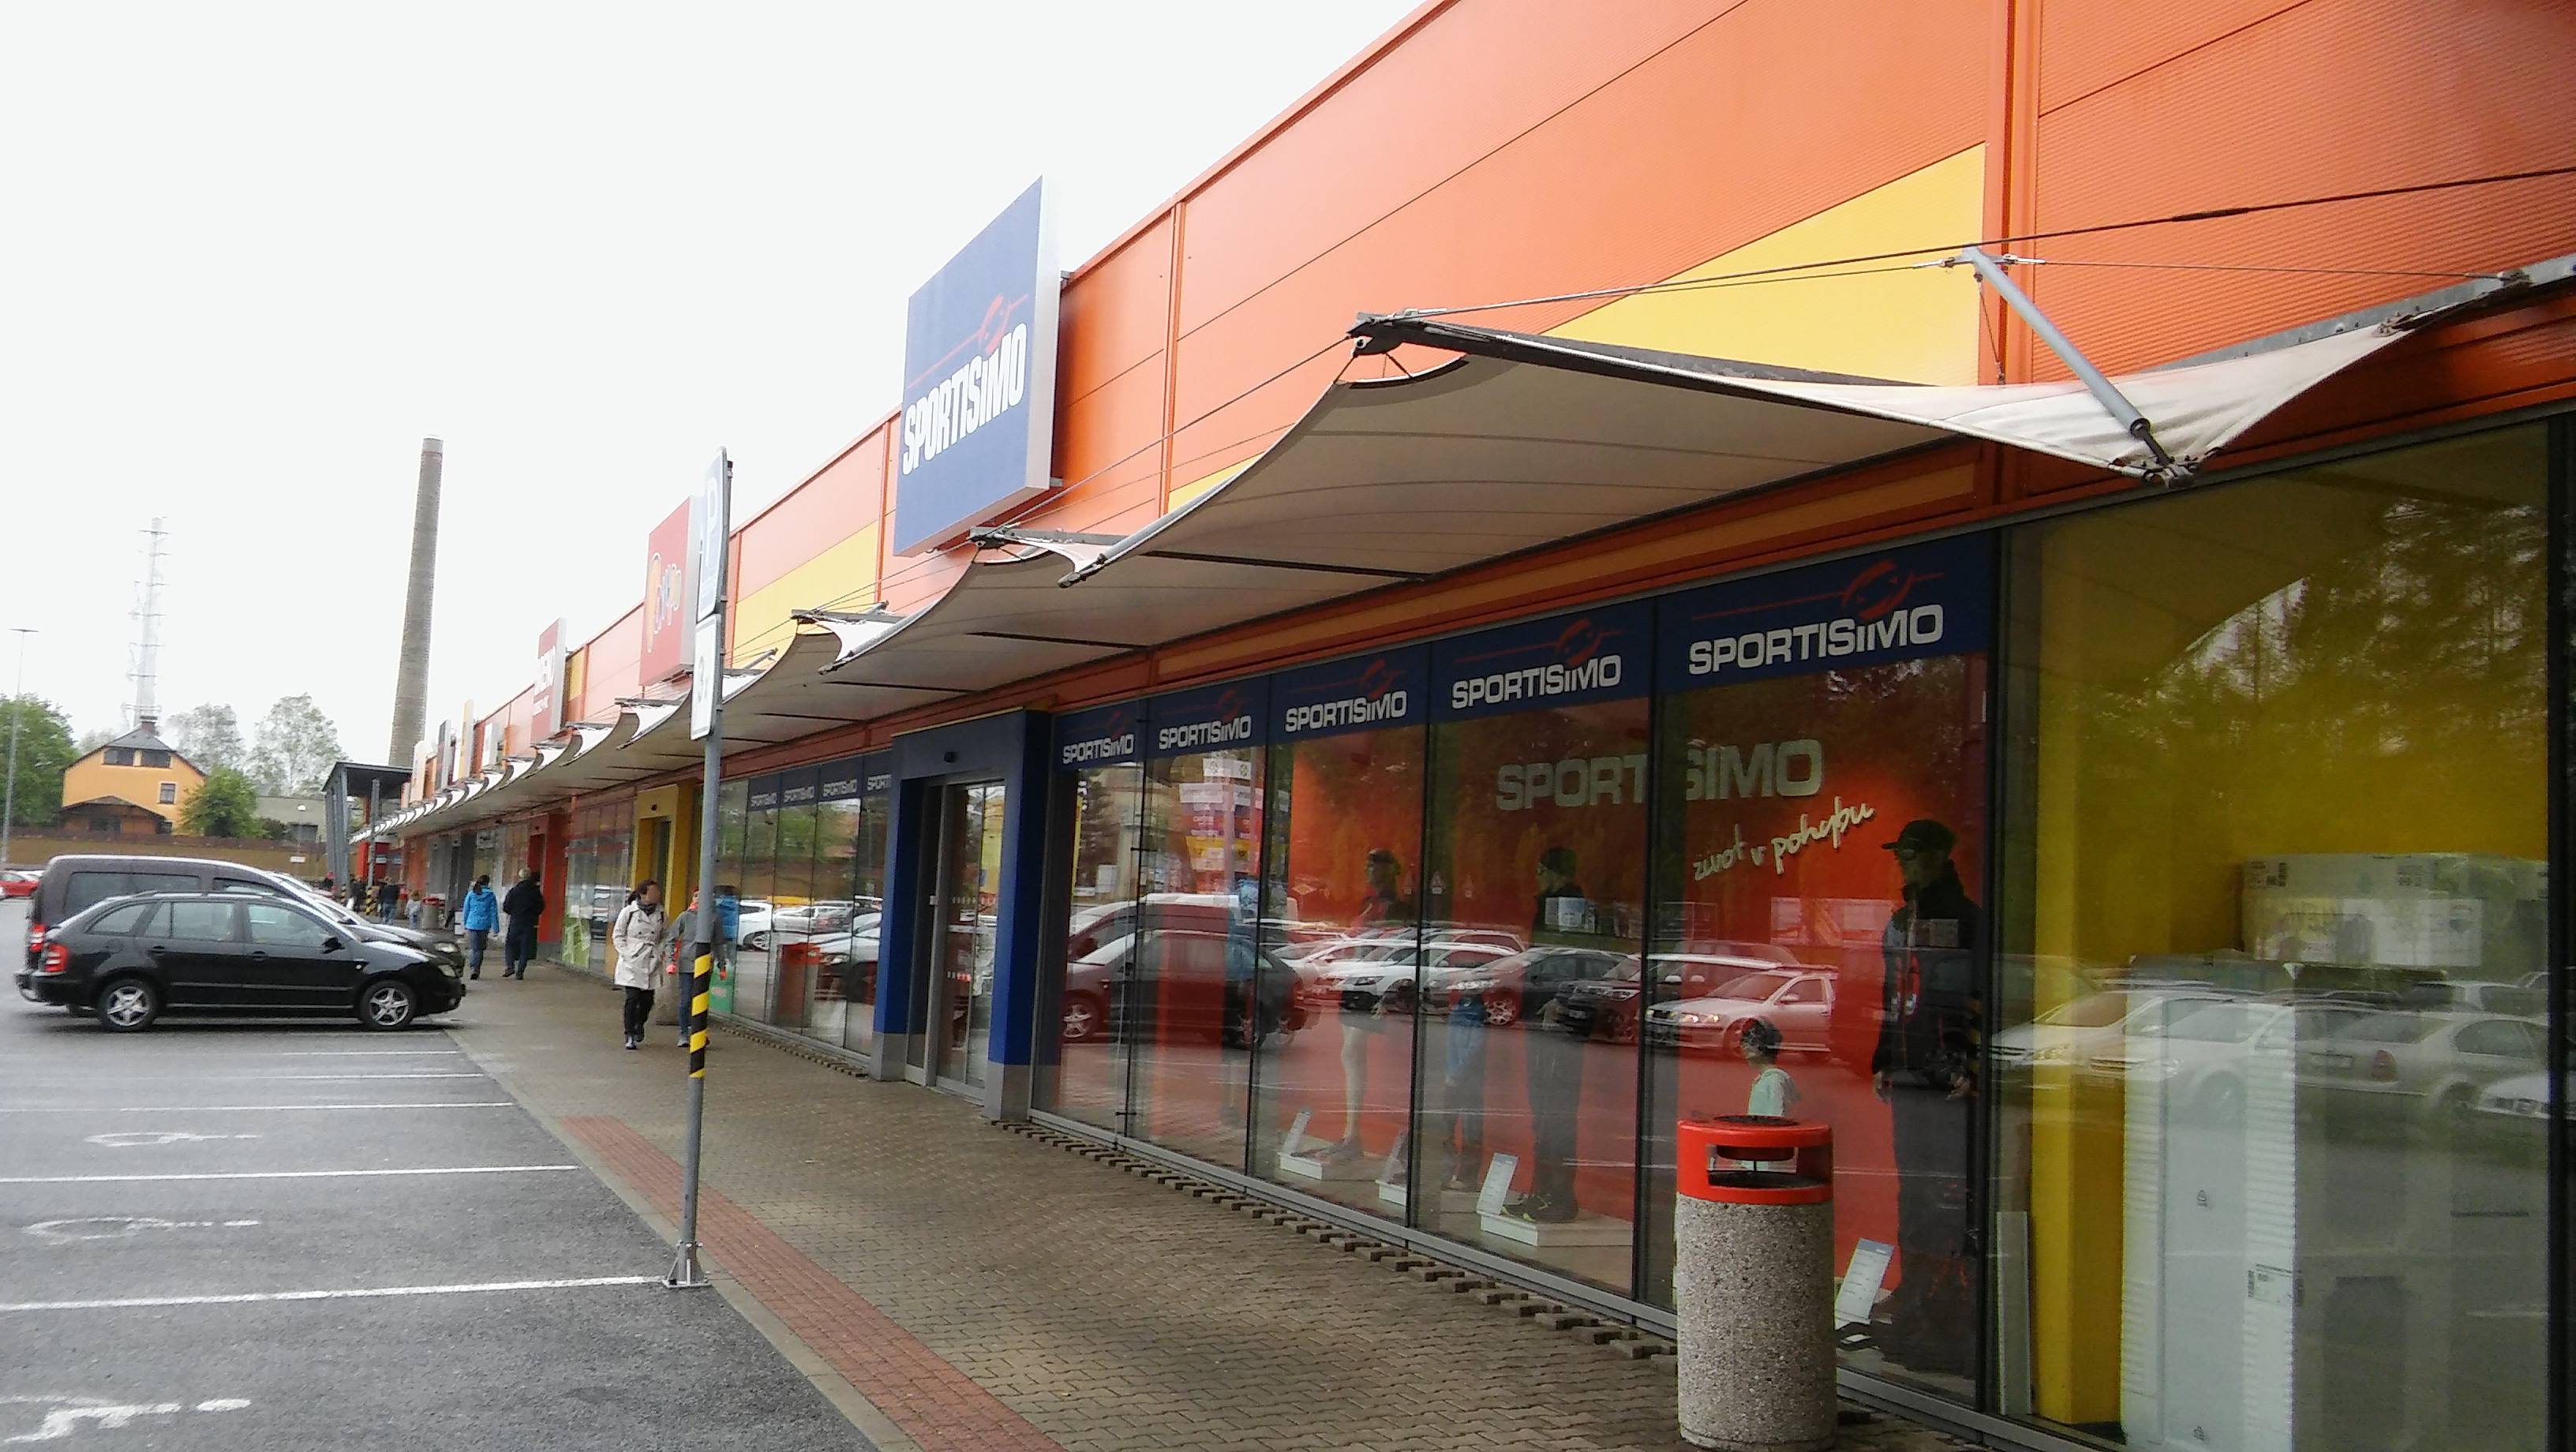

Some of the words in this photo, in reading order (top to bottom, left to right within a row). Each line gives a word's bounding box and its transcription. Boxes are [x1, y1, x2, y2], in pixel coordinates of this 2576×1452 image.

[902, 323, 1028, 475] SPORTISIMO
[1689, 604, 1944, 675] SPORTISIMO
[1285, 690, 1407, 733] SPORTISIMO
[1452, 654, 1622, 709] SPORTISIMO
[1062, 734, 1135, 765] SPORTISIMO
[1159, 715, 1251, 750] SPORTISIMO
[1496, 739, 1822, 811] SPORTSIMO
[1750, 845, 1766, 866] v
[1771, 795, 1875, 875] pohybu
